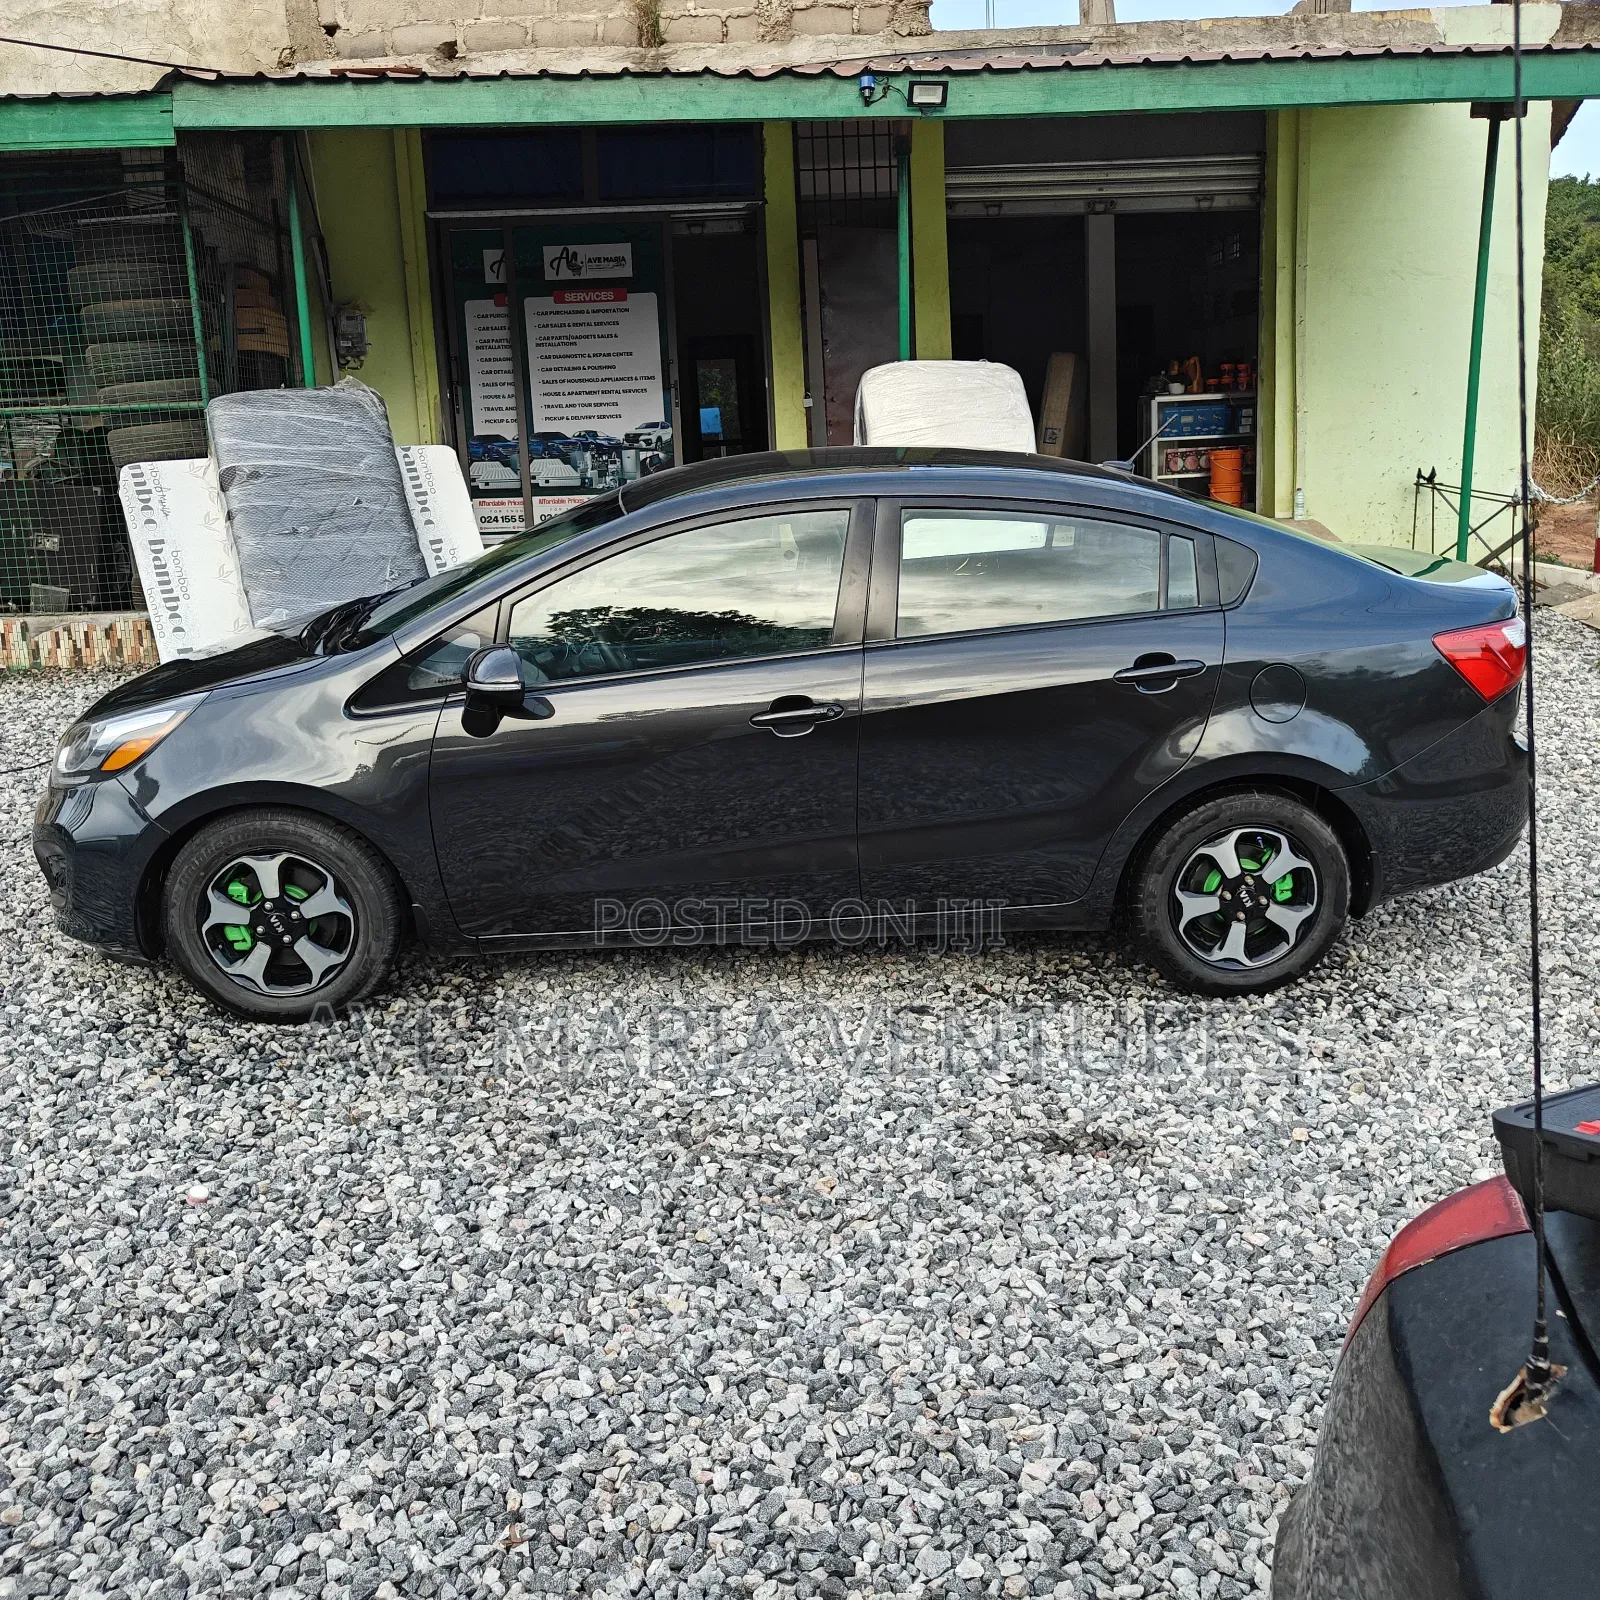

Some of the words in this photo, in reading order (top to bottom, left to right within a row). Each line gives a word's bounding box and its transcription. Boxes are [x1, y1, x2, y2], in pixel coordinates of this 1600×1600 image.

[587, 256, 602, 264] AVE
[603, 255, 626, 263] MARIA
[564, 291, 614, 302] SERVICES
[417, 447, 437, 495] bamboo
[480, 515, 499, 524] 024
[500, 515, 517, 523] 155
[148, 539, 187, 640] bamboo
[171, 549, 191, 601] bamboo
[147, 587, 166, 639] bamboo
[270, 915, 285, 933] KIA
